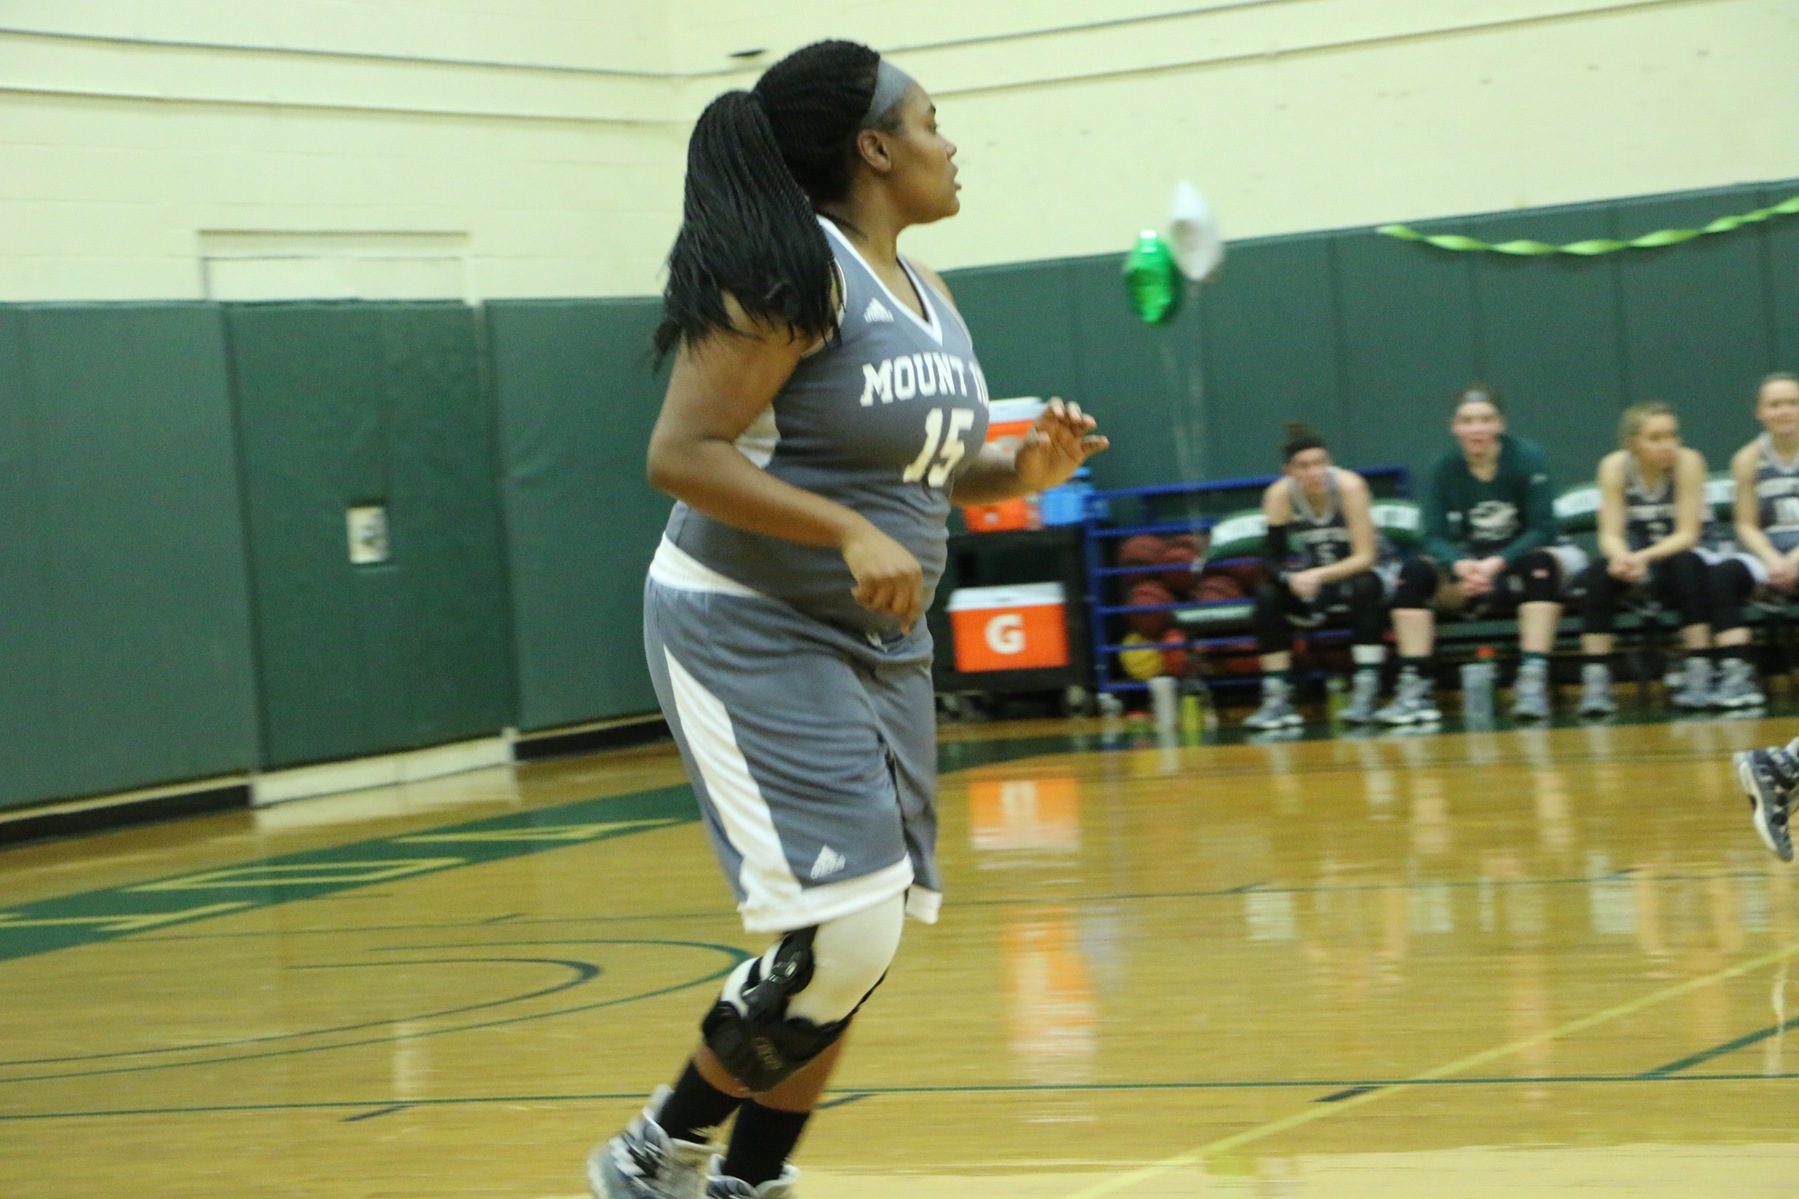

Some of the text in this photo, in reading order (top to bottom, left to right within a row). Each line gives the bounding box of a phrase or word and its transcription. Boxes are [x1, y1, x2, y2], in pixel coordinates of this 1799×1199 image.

[860, 352, 968, 407] MOUNT
[903, 408, 975, 488] 15
[985, 612, 1026, 655] G
